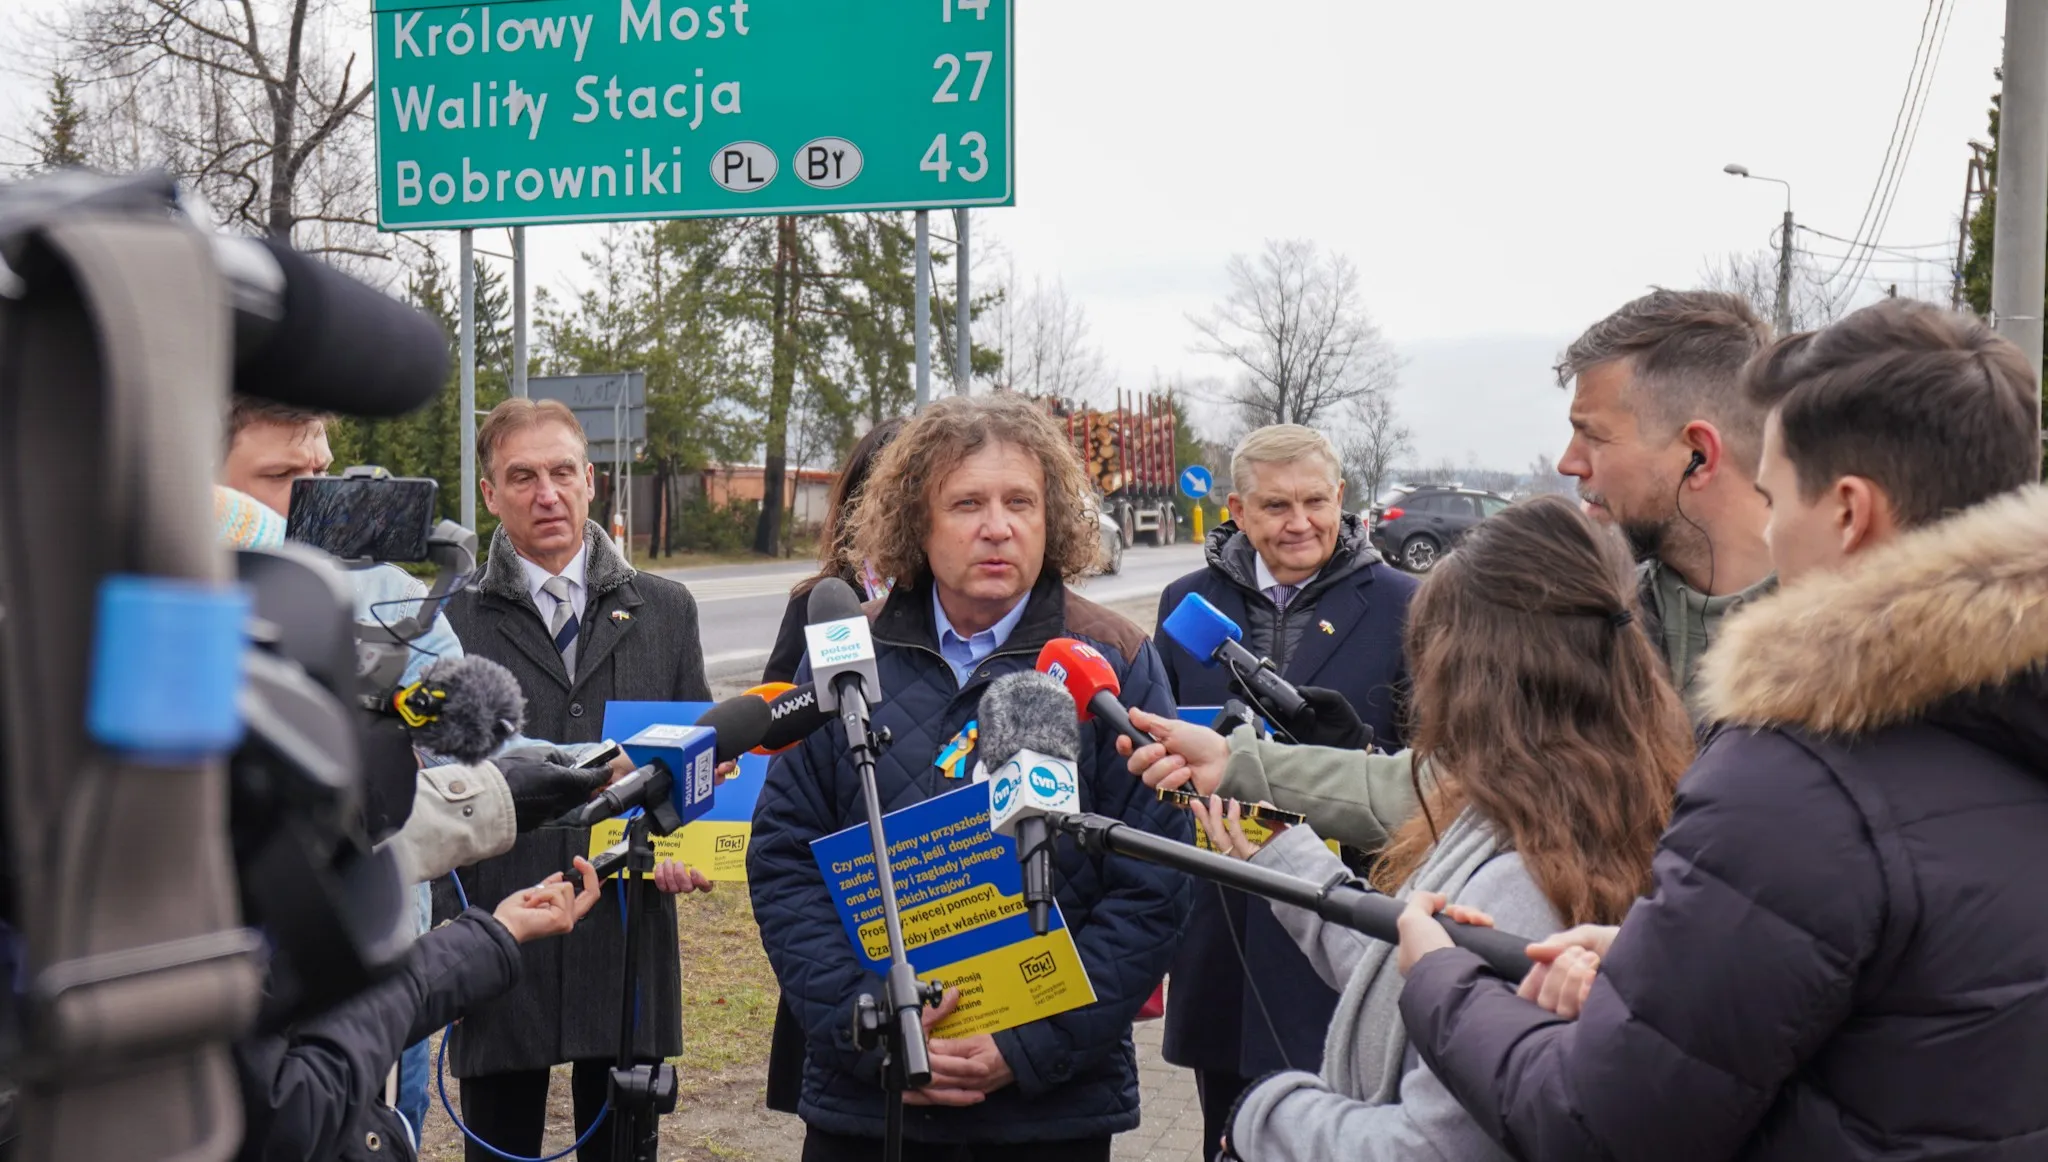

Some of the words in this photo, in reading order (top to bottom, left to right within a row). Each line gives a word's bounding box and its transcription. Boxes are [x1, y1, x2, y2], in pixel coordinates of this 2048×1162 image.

[394, 7, 593, 62] Królowy
[619, 0, 750, 44] Most
[391, 79, 548, 140] Waliły
[572, 68, 741, 130] Stacja
[932, 51, 993, 104] 27
[397, 147, 682, 207] Bobrowniki
[724, 150, 764, 184] PL
[808, 146, 844, 180] BY
[919, 131, 989, 183] 43
[821, 642, 861, 657] polsat
[826, 651, 860, 663] news
[1031, 770, 1075, 795] tvn24
[719, 838, 742, 849] Tak!
[832, 859, 853, 874] Czy
[919, 833, 930, 843] w
[839, 869, 875, 891] zaufać
[922, 844, 946, 864] jeśli
[948, 829, 993, 853] dopuści
[846, 893, 867, 907] ona
[867, 886, 881, 899] do
[910, 873, 916, 885] i
[915, 858, 959, 884] zagłady
[959, 845, 1006, 869] jednego
[853, 913, 860, 923] z
[929, 873, 971, 896] krajów?
[909, 902, 949, 924] więcej
[948, 886, 995, 914] pomocy!
[868, 945, 890, 958] Cza
[903, 931, 928, 947] róby
[928, 923, 952, 941] jest
[952, 909, 997, 931] właśnie
[1024, 957, 1052, 976] Tak!
